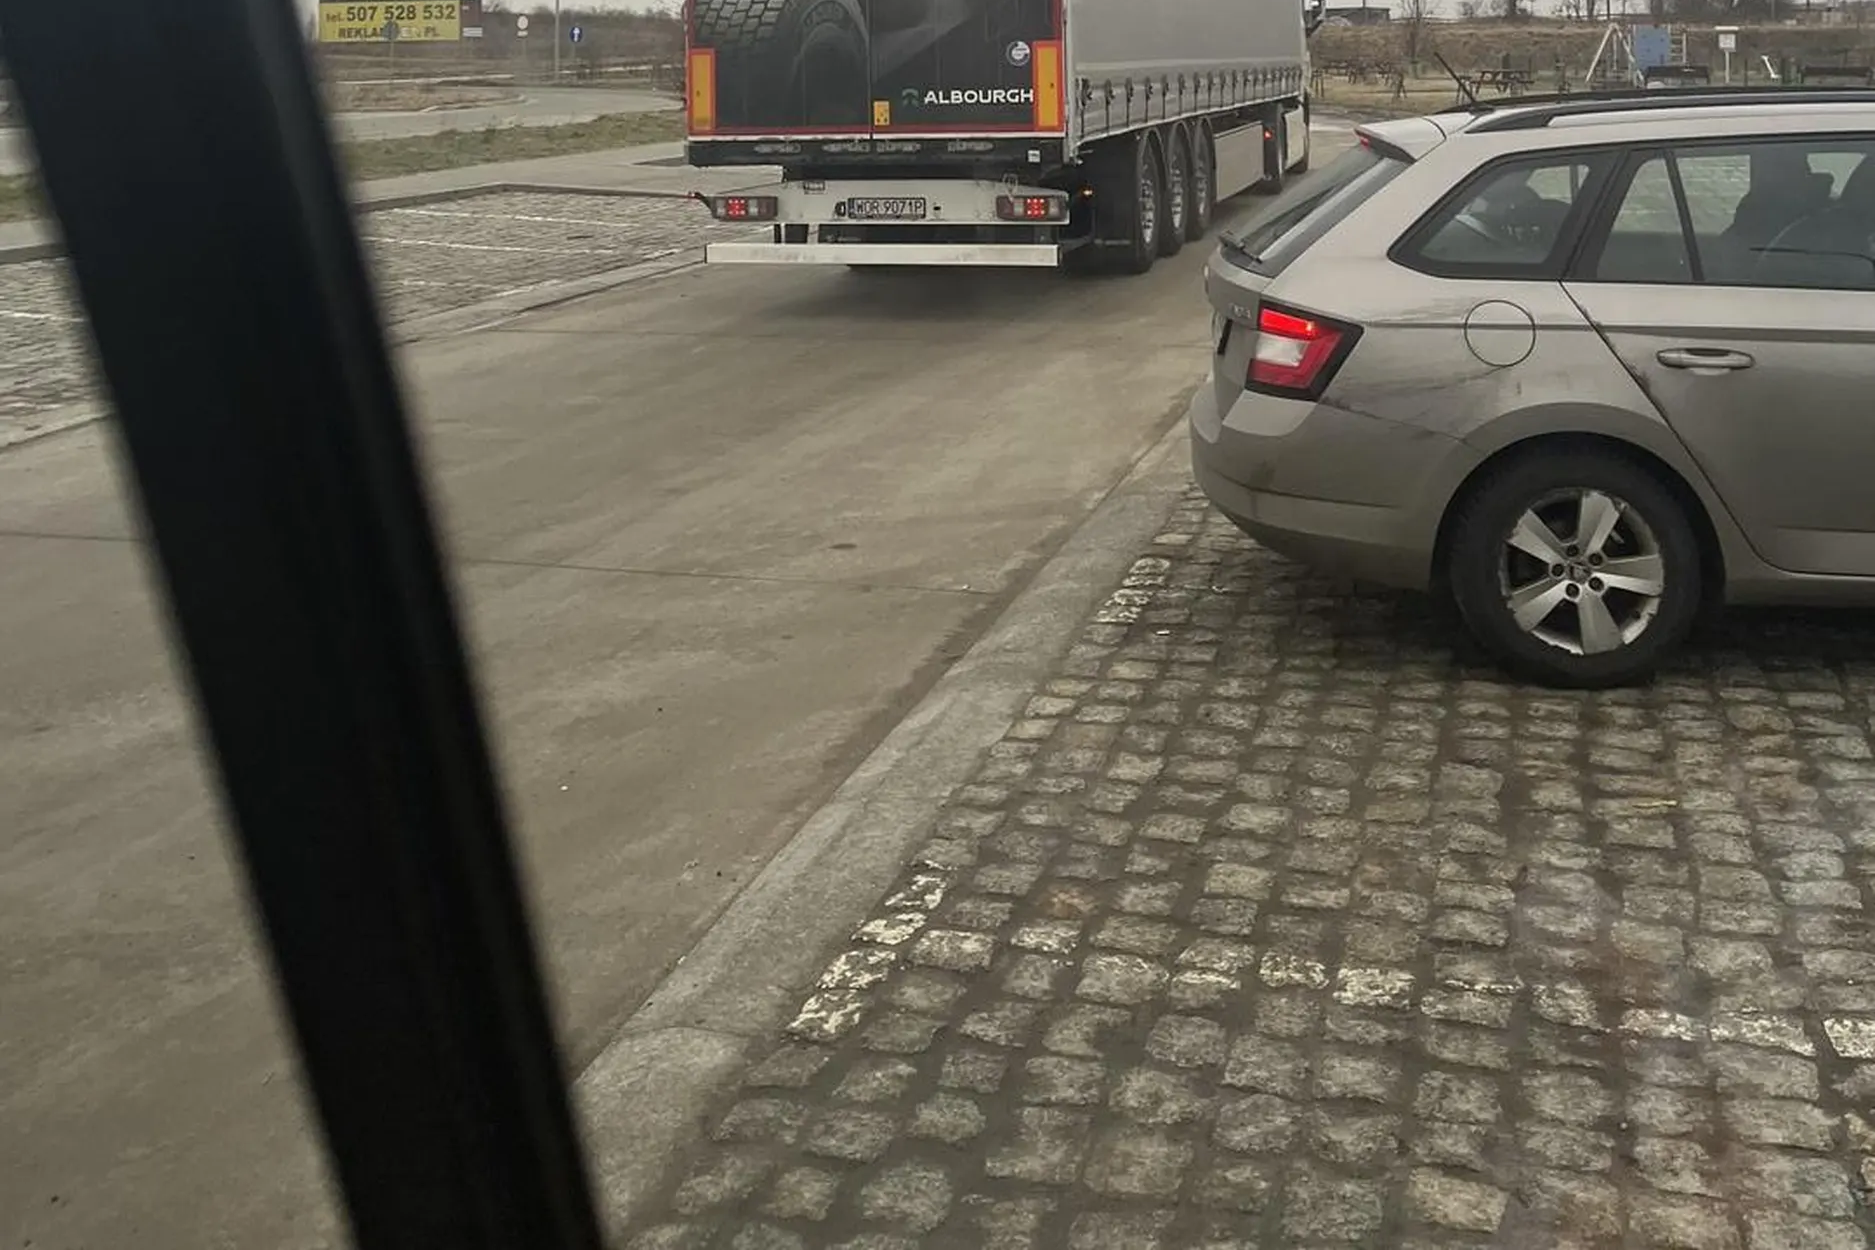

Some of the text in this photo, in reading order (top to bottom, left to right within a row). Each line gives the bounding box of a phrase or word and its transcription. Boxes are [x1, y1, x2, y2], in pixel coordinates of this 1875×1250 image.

[346, 6, 378, 22] 507
[384, 5, 417, 21] 528
[423, 4, 457, 20] 532
[924, 89, 1034, 105] ALBOURGH
